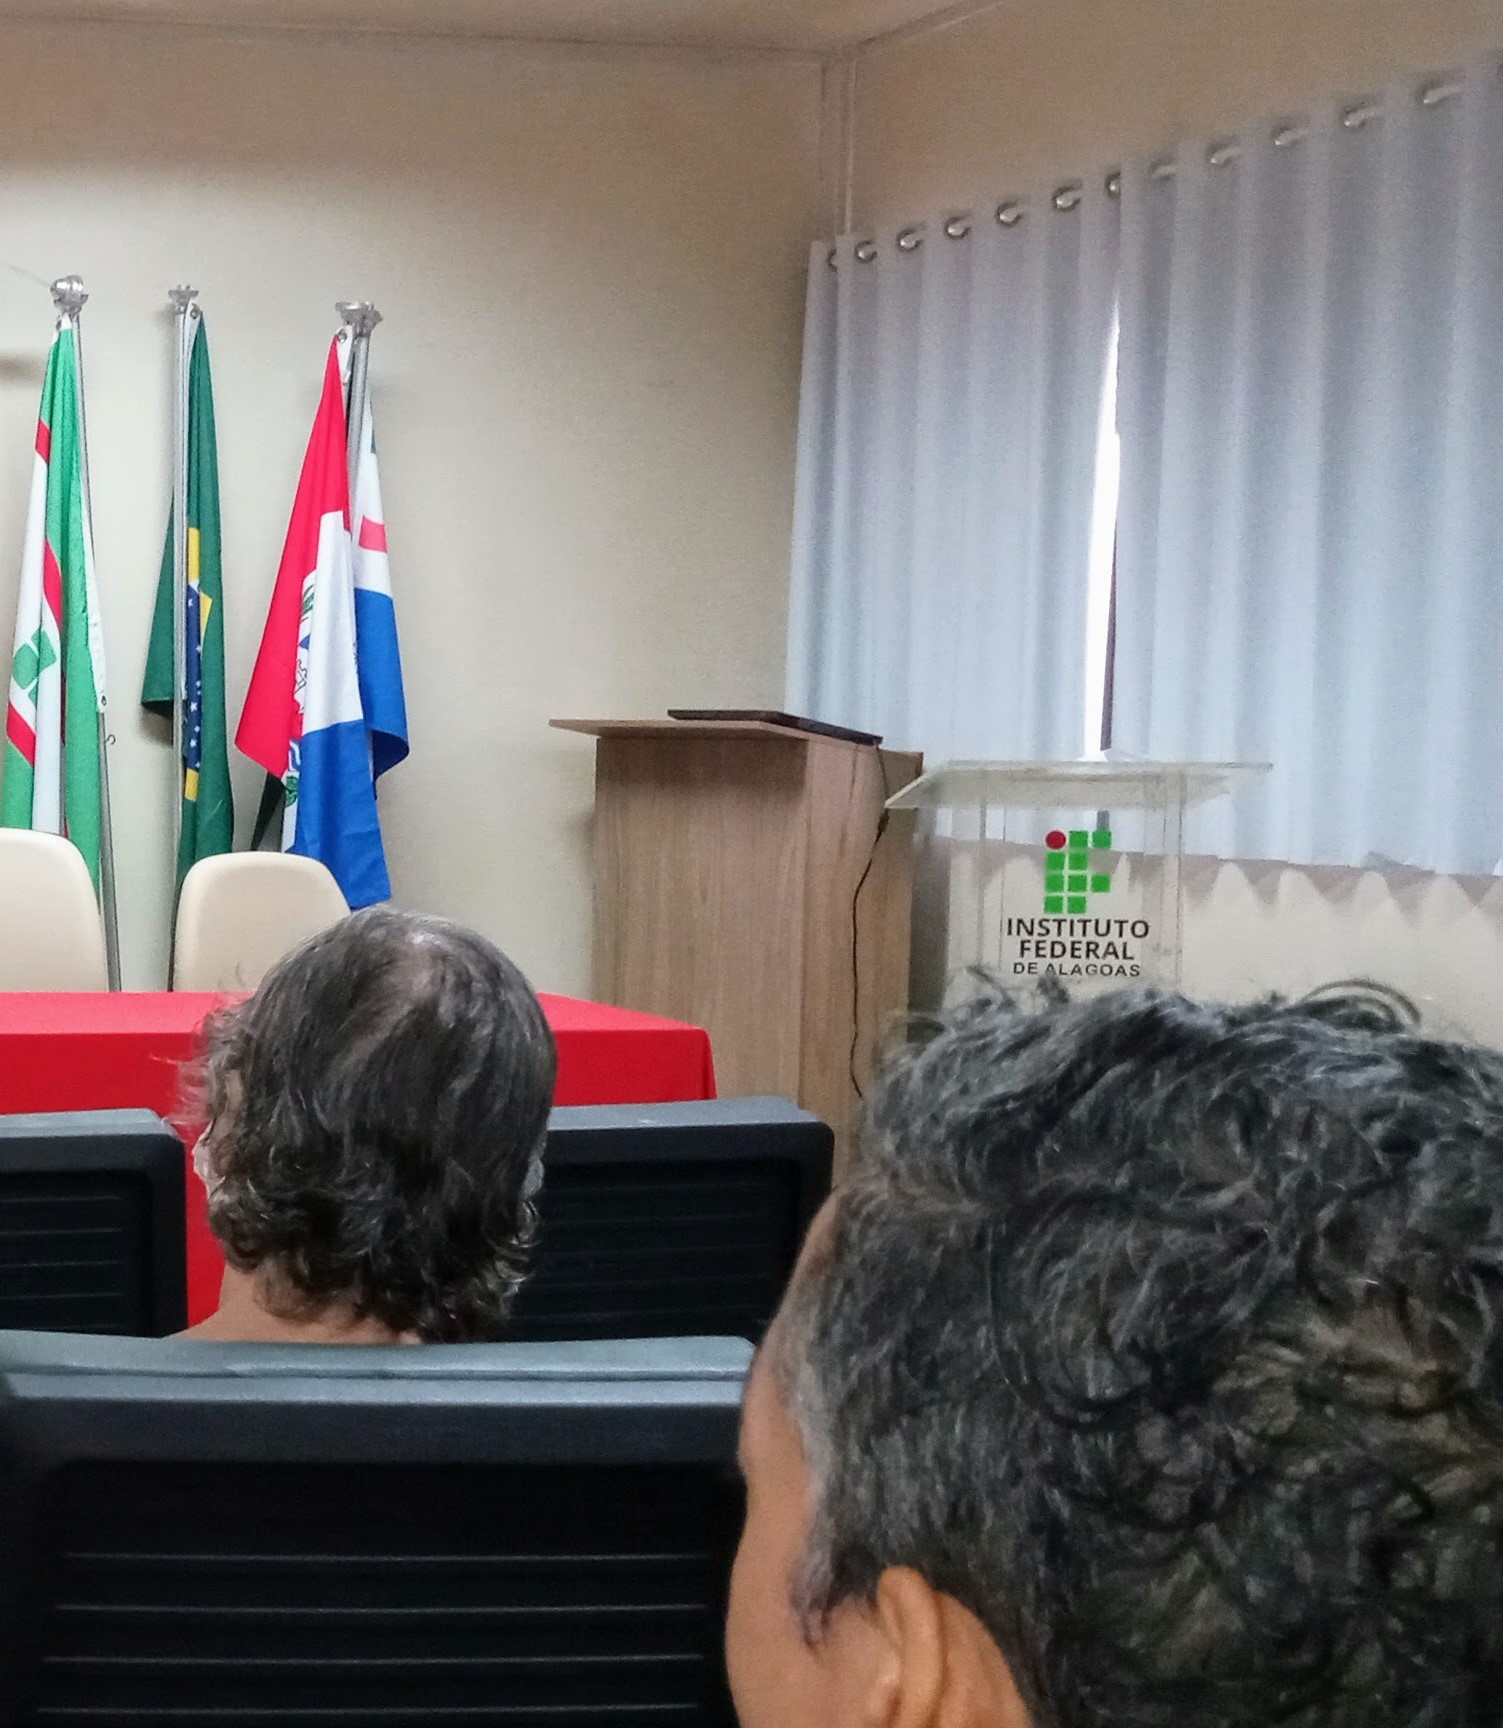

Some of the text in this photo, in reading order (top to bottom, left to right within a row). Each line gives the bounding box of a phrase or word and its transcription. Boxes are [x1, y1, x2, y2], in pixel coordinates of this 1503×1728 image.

[1007, 918, 1150, 938] INSTITUTO
[1019, 939, 1135, 960] FEDERAL
[1013, 962, 1141, 977] DE ALAGOAS
